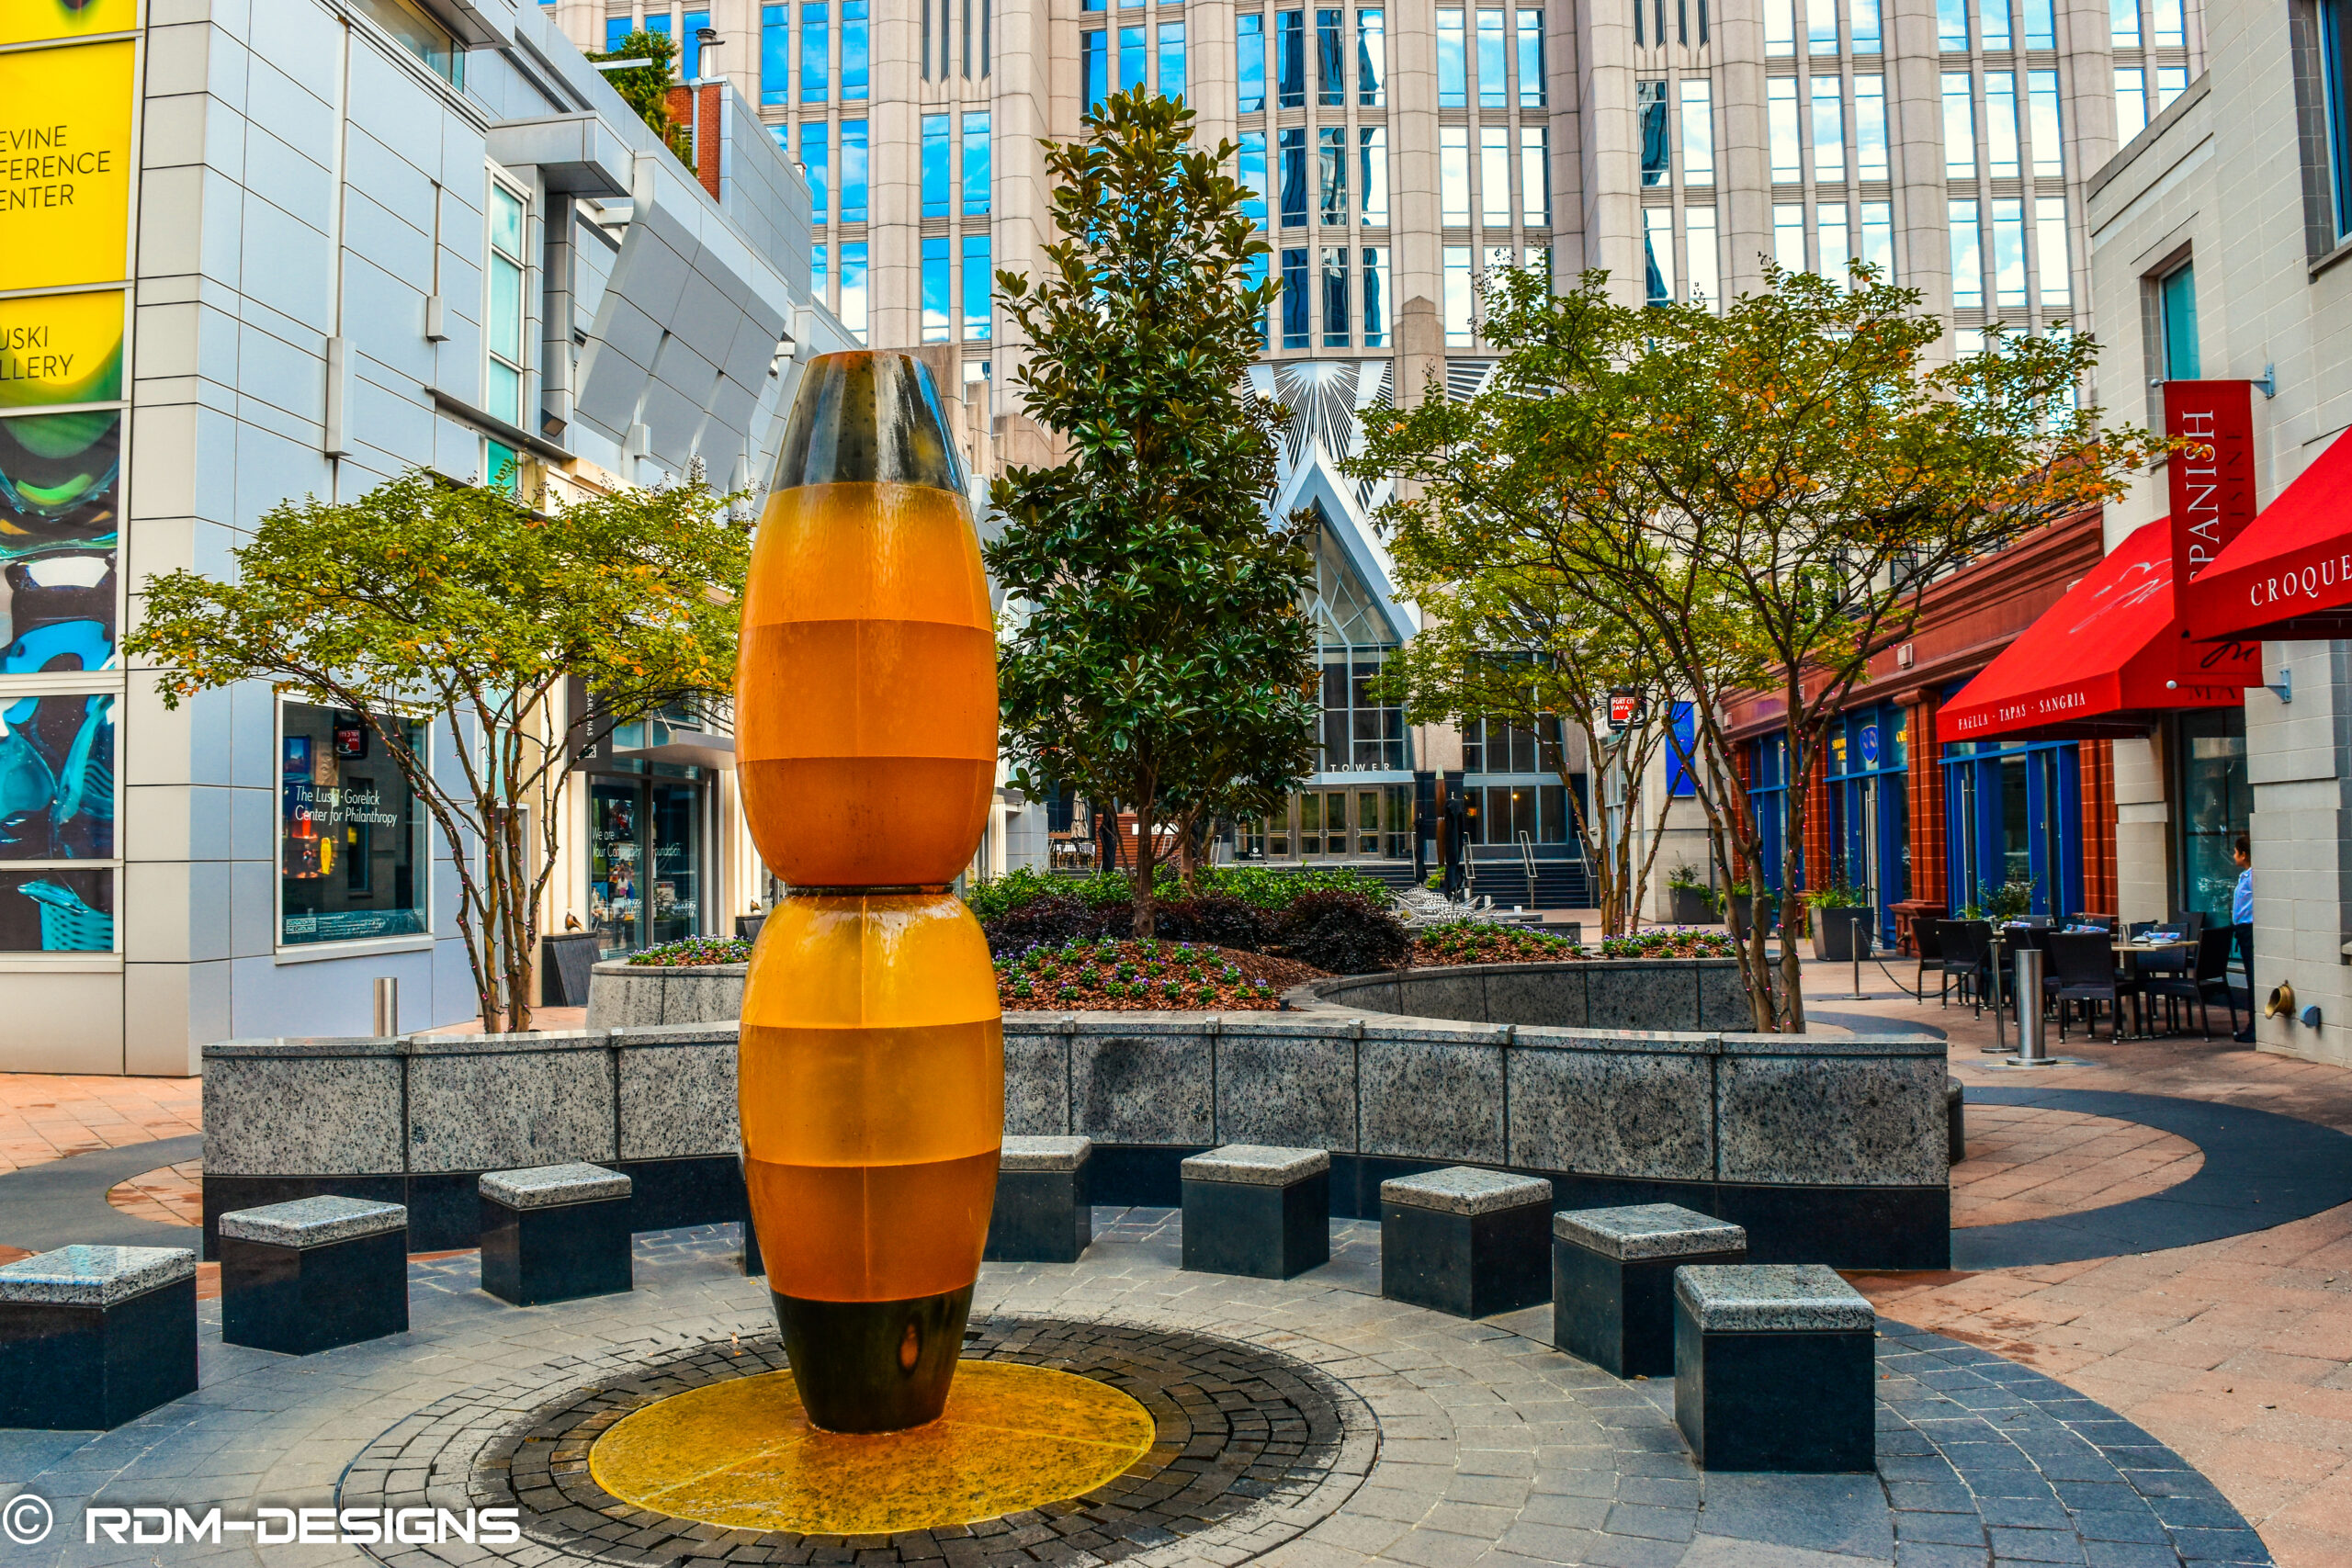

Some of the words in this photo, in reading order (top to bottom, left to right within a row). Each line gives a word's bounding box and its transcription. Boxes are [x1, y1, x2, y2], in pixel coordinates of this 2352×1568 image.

[0, 125, 67, 152] EVINE
[0, 151, 111, 181] FERENCE
[0, 184, 74, 212] ENTER
[0, 354, 74, 381] LLERY
[2250, 554, 2352, 607] CROQUE
[1999, 704, 2027, 722] TAPAS
[2040, 692, 2086, 714] SANGRIA
[1329, 762, 1390, 773] TOWER
[296, 785, 313, 802] The
[316, 786, 340, 804] Luski
[345, 788, 380, 806] Gorelick
[295, 804, 328, 821] Center
[328, 807, 344, 826] for
[345, 807, 398, 828] Philanthropy
[592, 827, 603, 840] We
[604, 830, 615, 840] are
[593, 843, 606, 858] Your
[607, 842, 642, 860] Comity
